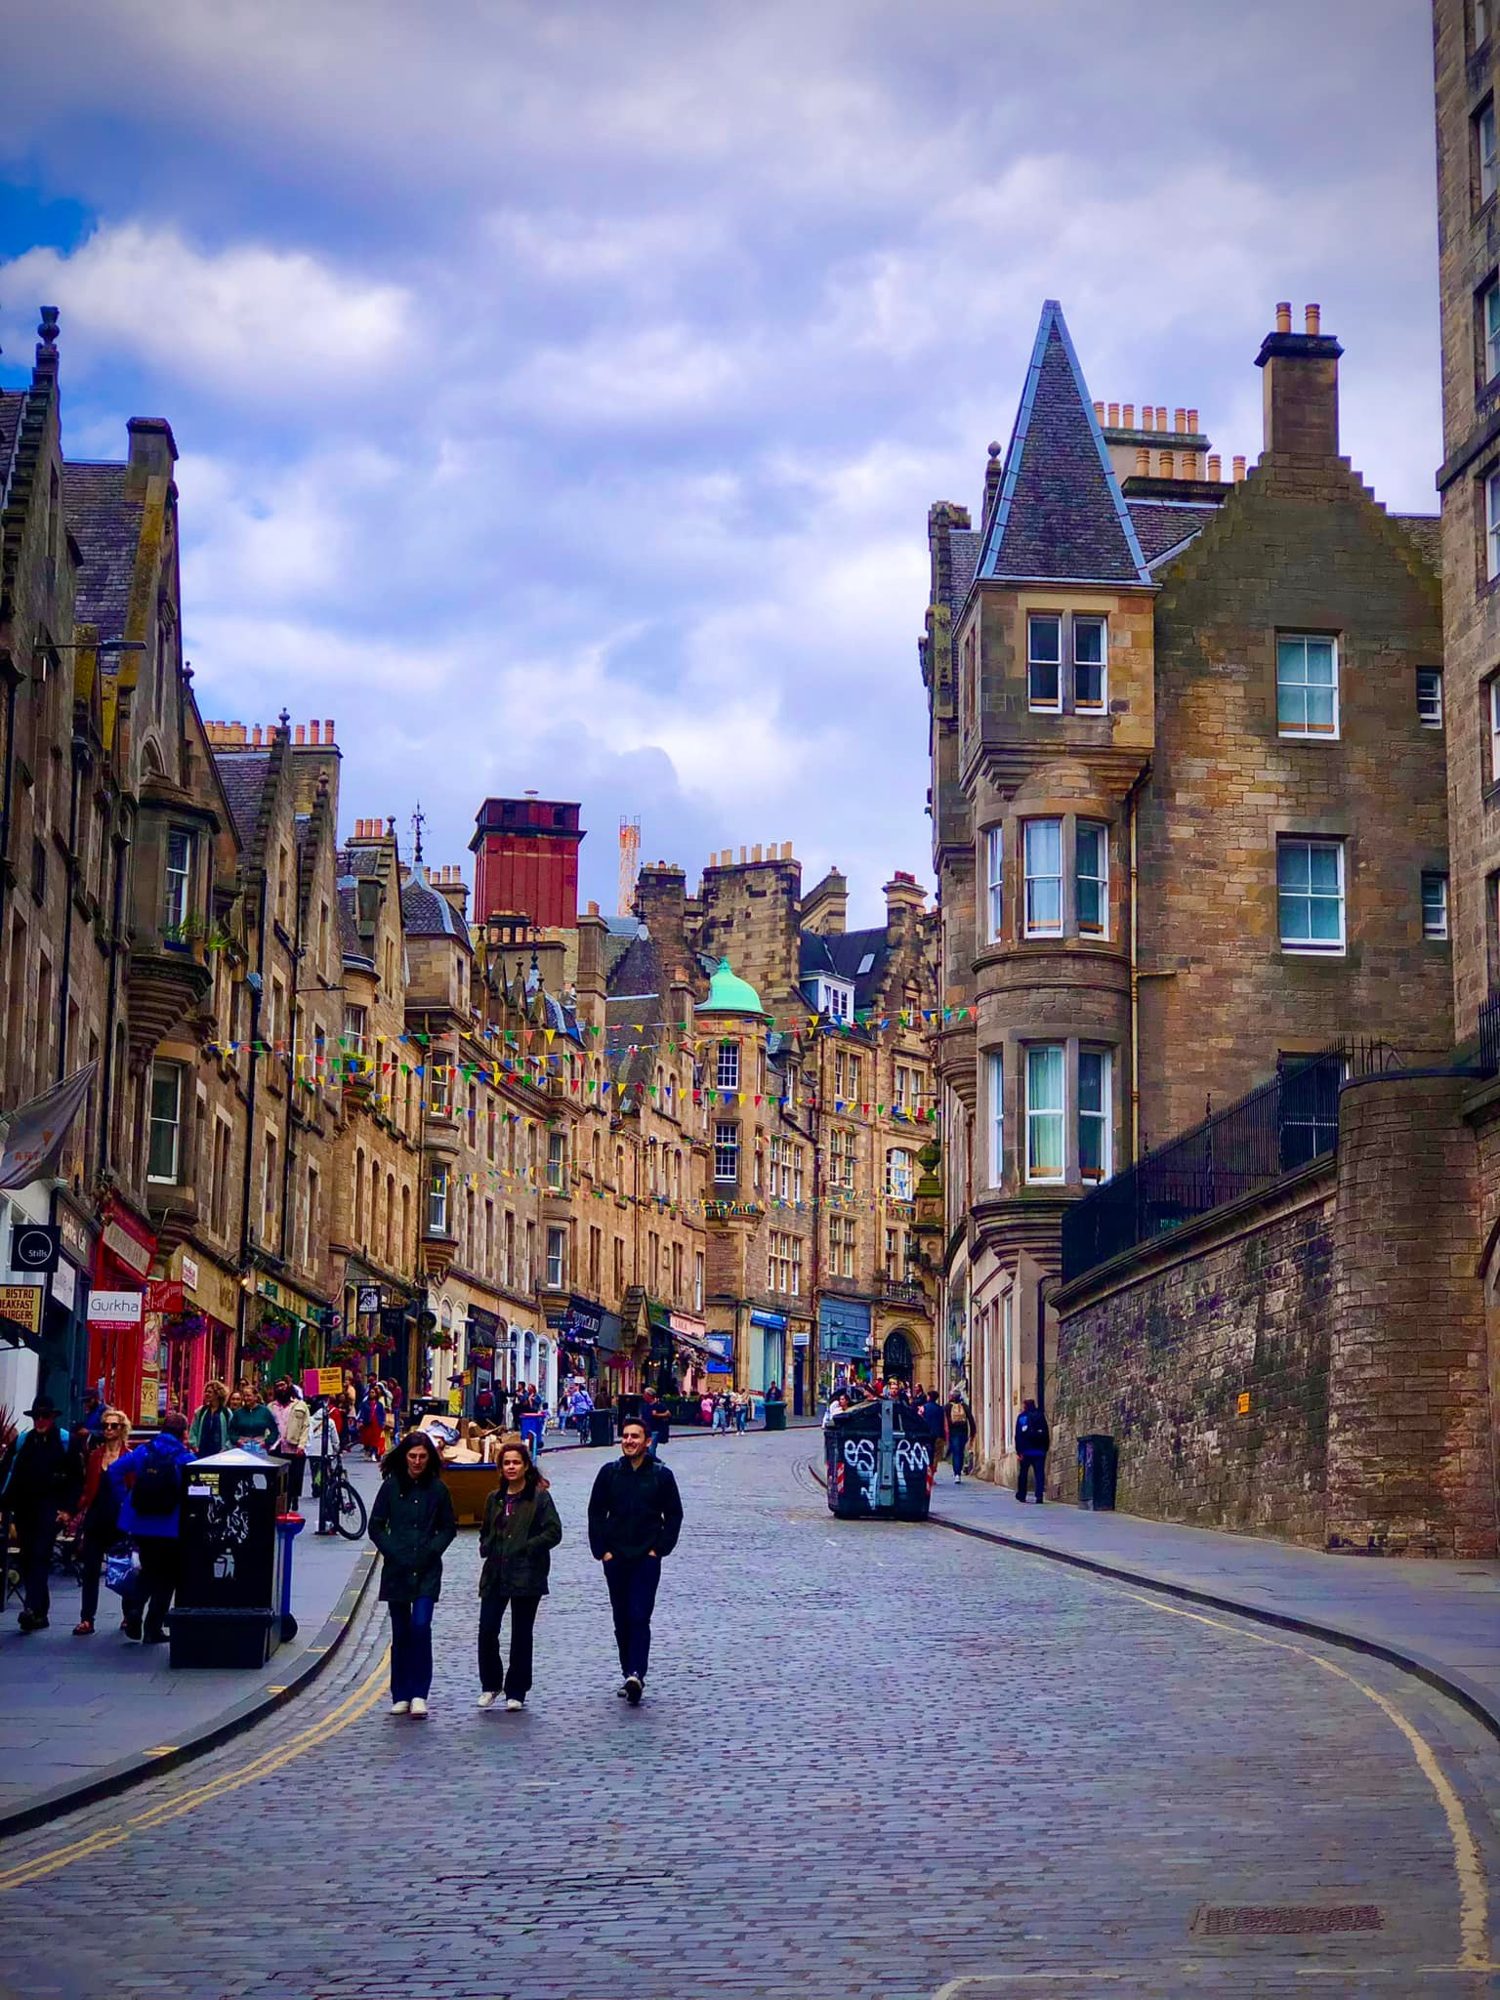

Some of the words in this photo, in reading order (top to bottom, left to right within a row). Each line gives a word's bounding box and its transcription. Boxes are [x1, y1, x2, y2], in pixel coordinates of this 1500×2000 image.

[28, 1250, 48, 1258] Stills
[6, 1288, 34, 1299] BISTRO
[0, 1299, 34, 1309] EAKFAST
[91, 1298, 139, 1313] Gurkha
